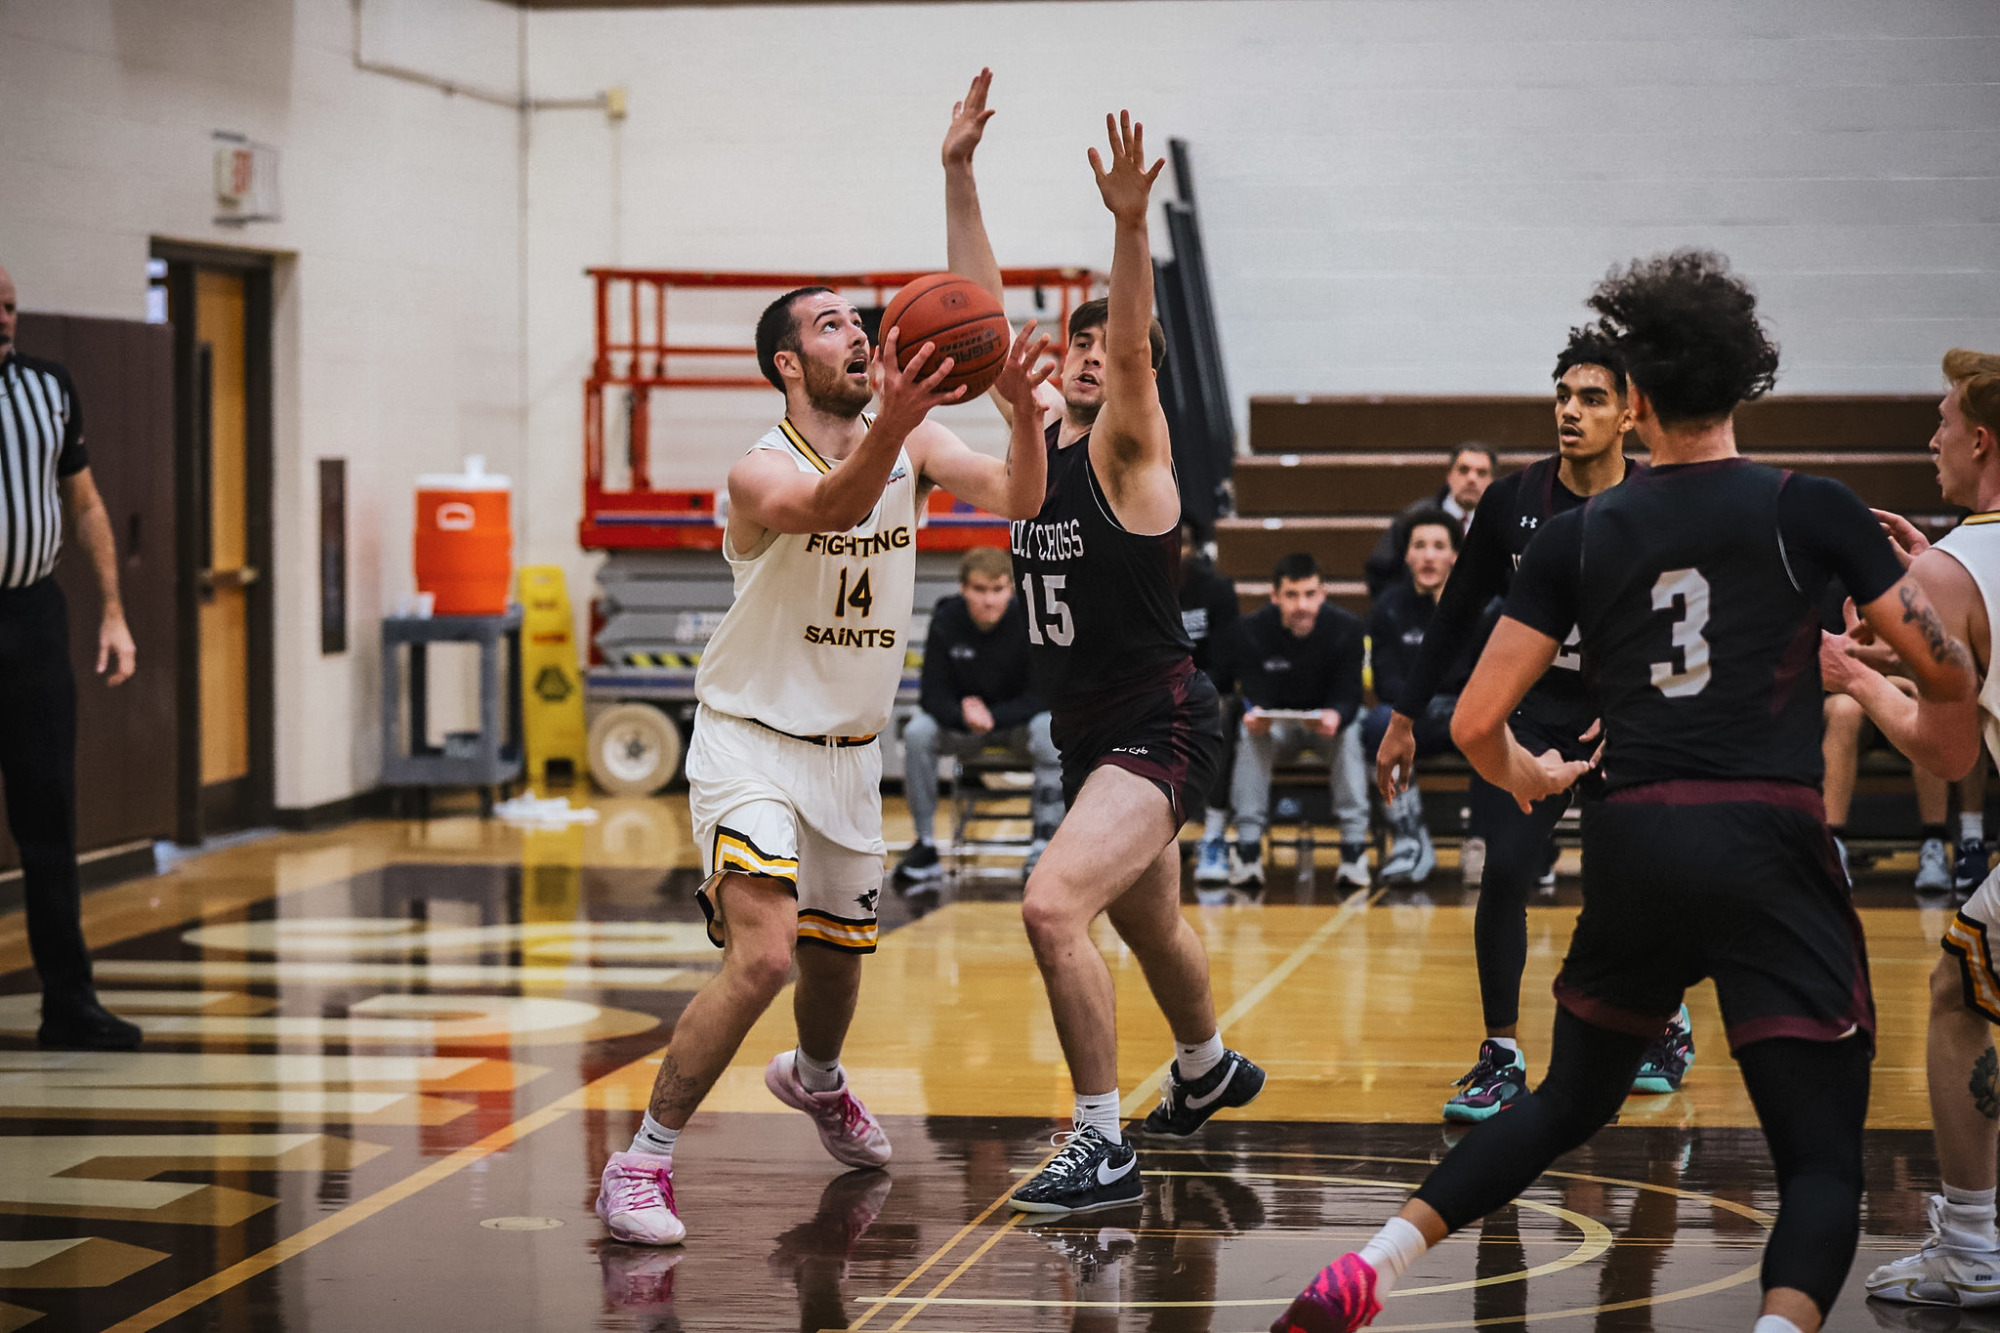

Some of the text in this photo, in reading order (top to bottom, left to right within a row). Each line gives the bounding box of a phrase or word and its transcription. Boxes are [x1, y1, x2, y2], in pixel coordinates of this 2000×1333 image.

[805, 525, 911, 558] FIGHTNG
[1010, 518, 1084, 560] OLY CROSS
[834, 565, 873, 619] 14
[1021, 572, 1075, 647] 15
[1649, 567, 1712, 698] 3
